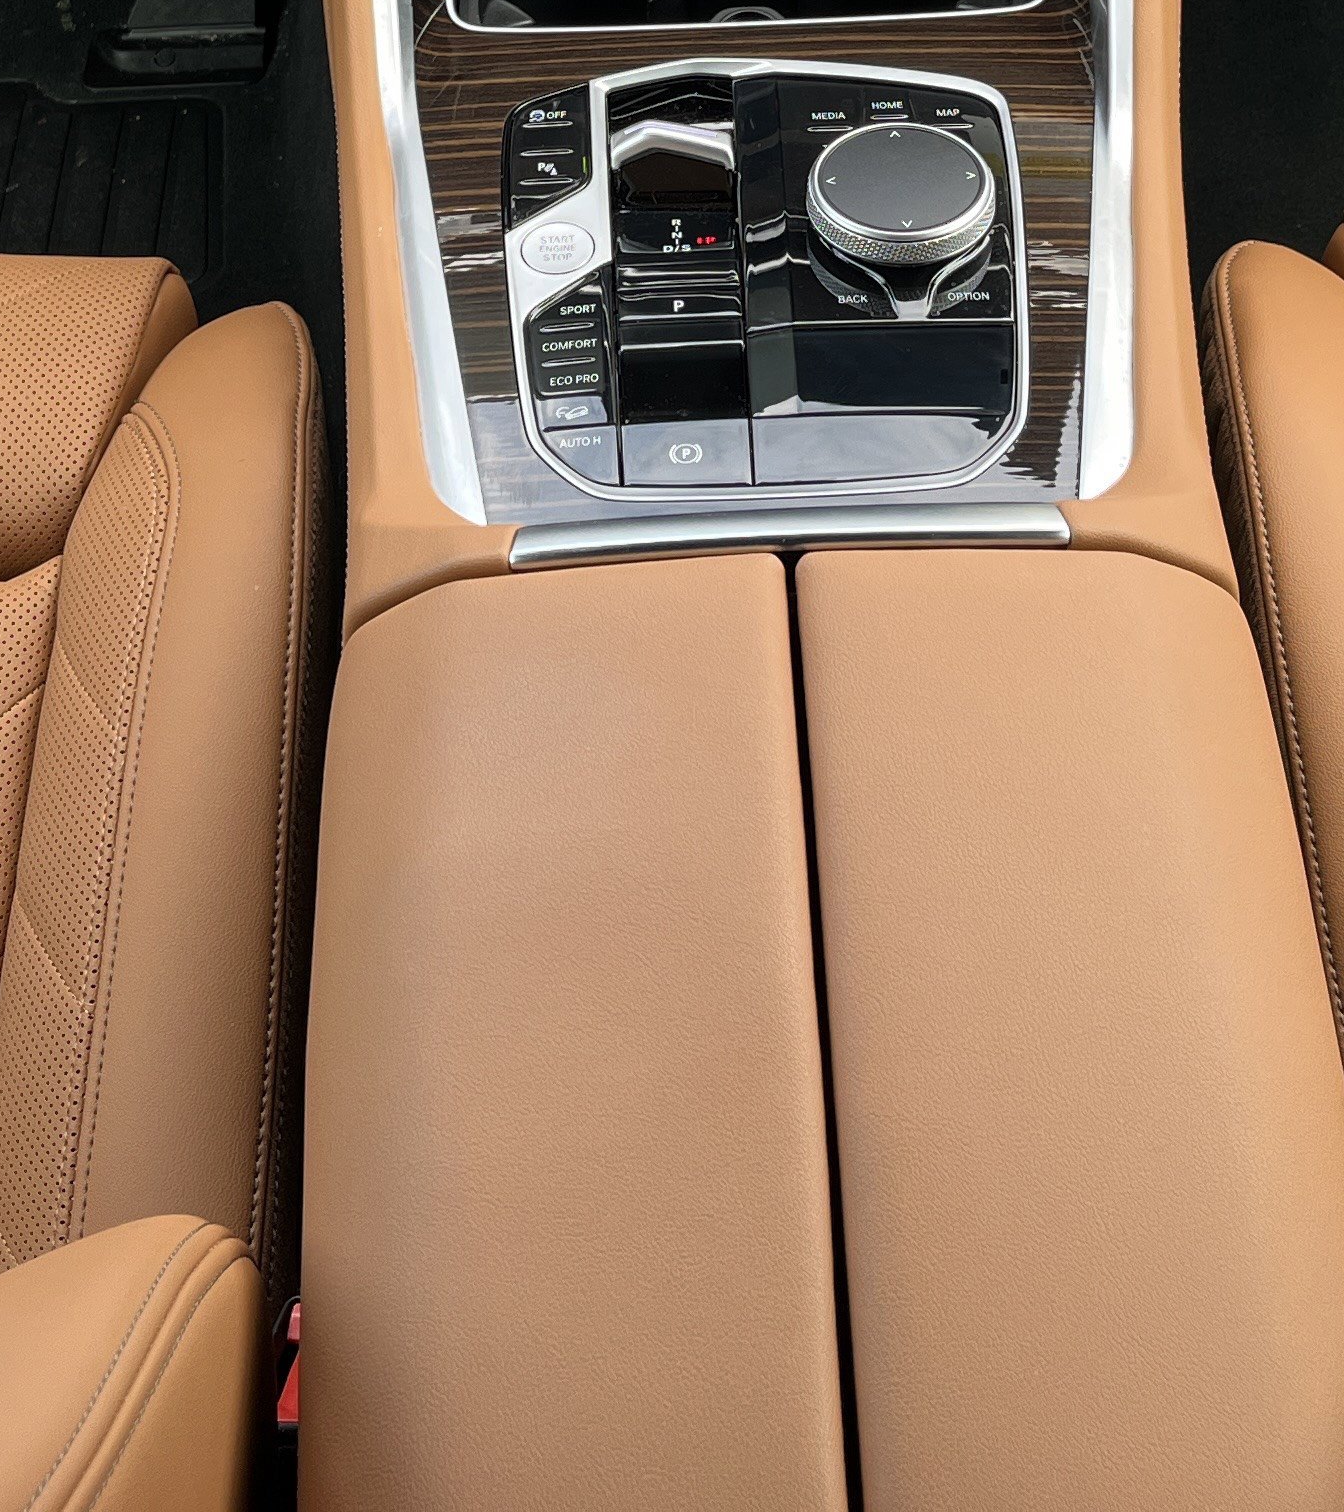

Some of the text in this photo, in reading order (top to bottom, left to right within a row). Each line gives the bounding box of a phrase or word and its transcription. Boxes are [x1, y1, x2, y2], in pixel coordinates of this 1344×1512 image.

[872, 101, 904, 110] HOME
[546, 110, 566, 119] OFF
[811, 112, 846, 120] MEDIA
[936, 109, 960, 117] MAP
[540, 235, 575, 244] START
[663, 244, 691, 253] D/S
[543, 253, 572, 262] STOP
[838, 294, 868, 304] BACK
[947, 292, 990, 301] OPTION
[560, 304, 596, 316] SPORT
[673, 300, 684, 312] P
[542, 338, 597, 352] COMFORT
[550, 374, 599, 386] ECO PRO
[559, 436, 601, 449] AUTO H
